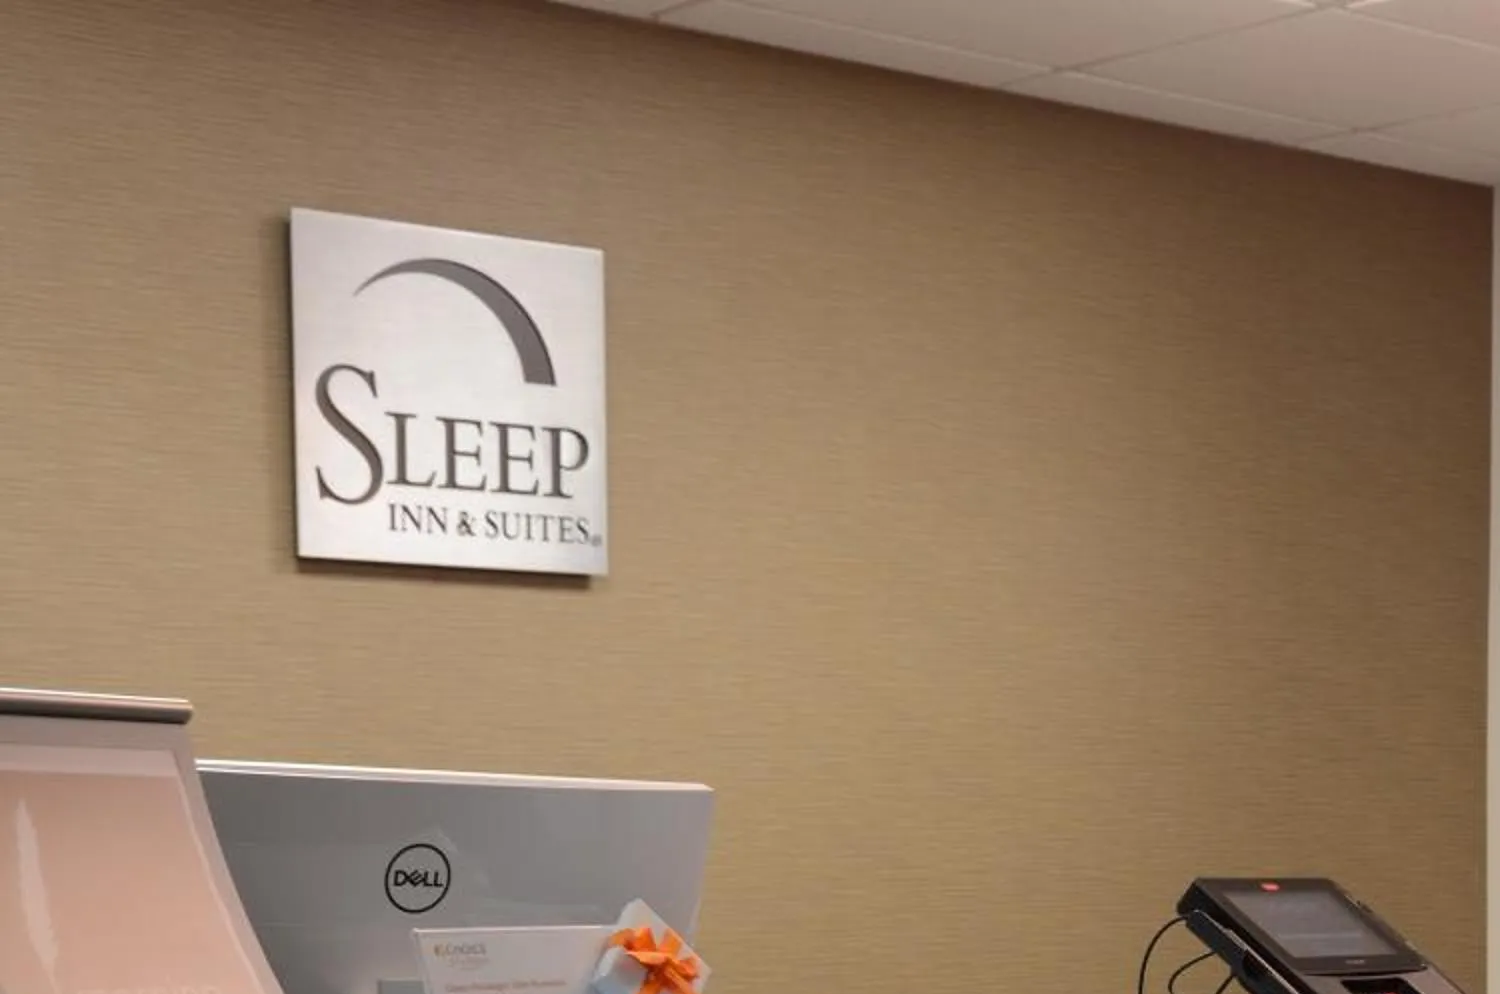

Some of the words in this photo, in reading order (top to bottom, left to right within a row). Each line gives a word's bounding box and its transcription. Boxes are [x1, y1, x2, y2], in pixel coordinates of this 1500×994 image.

[314, 364, 589, 505] SLEEP
[387, 503, 448, 535] INN
[456, 511, 477, 537] &
[484, 511, 590, 545] SUITES
[393, 869, 444, 888] DELL
